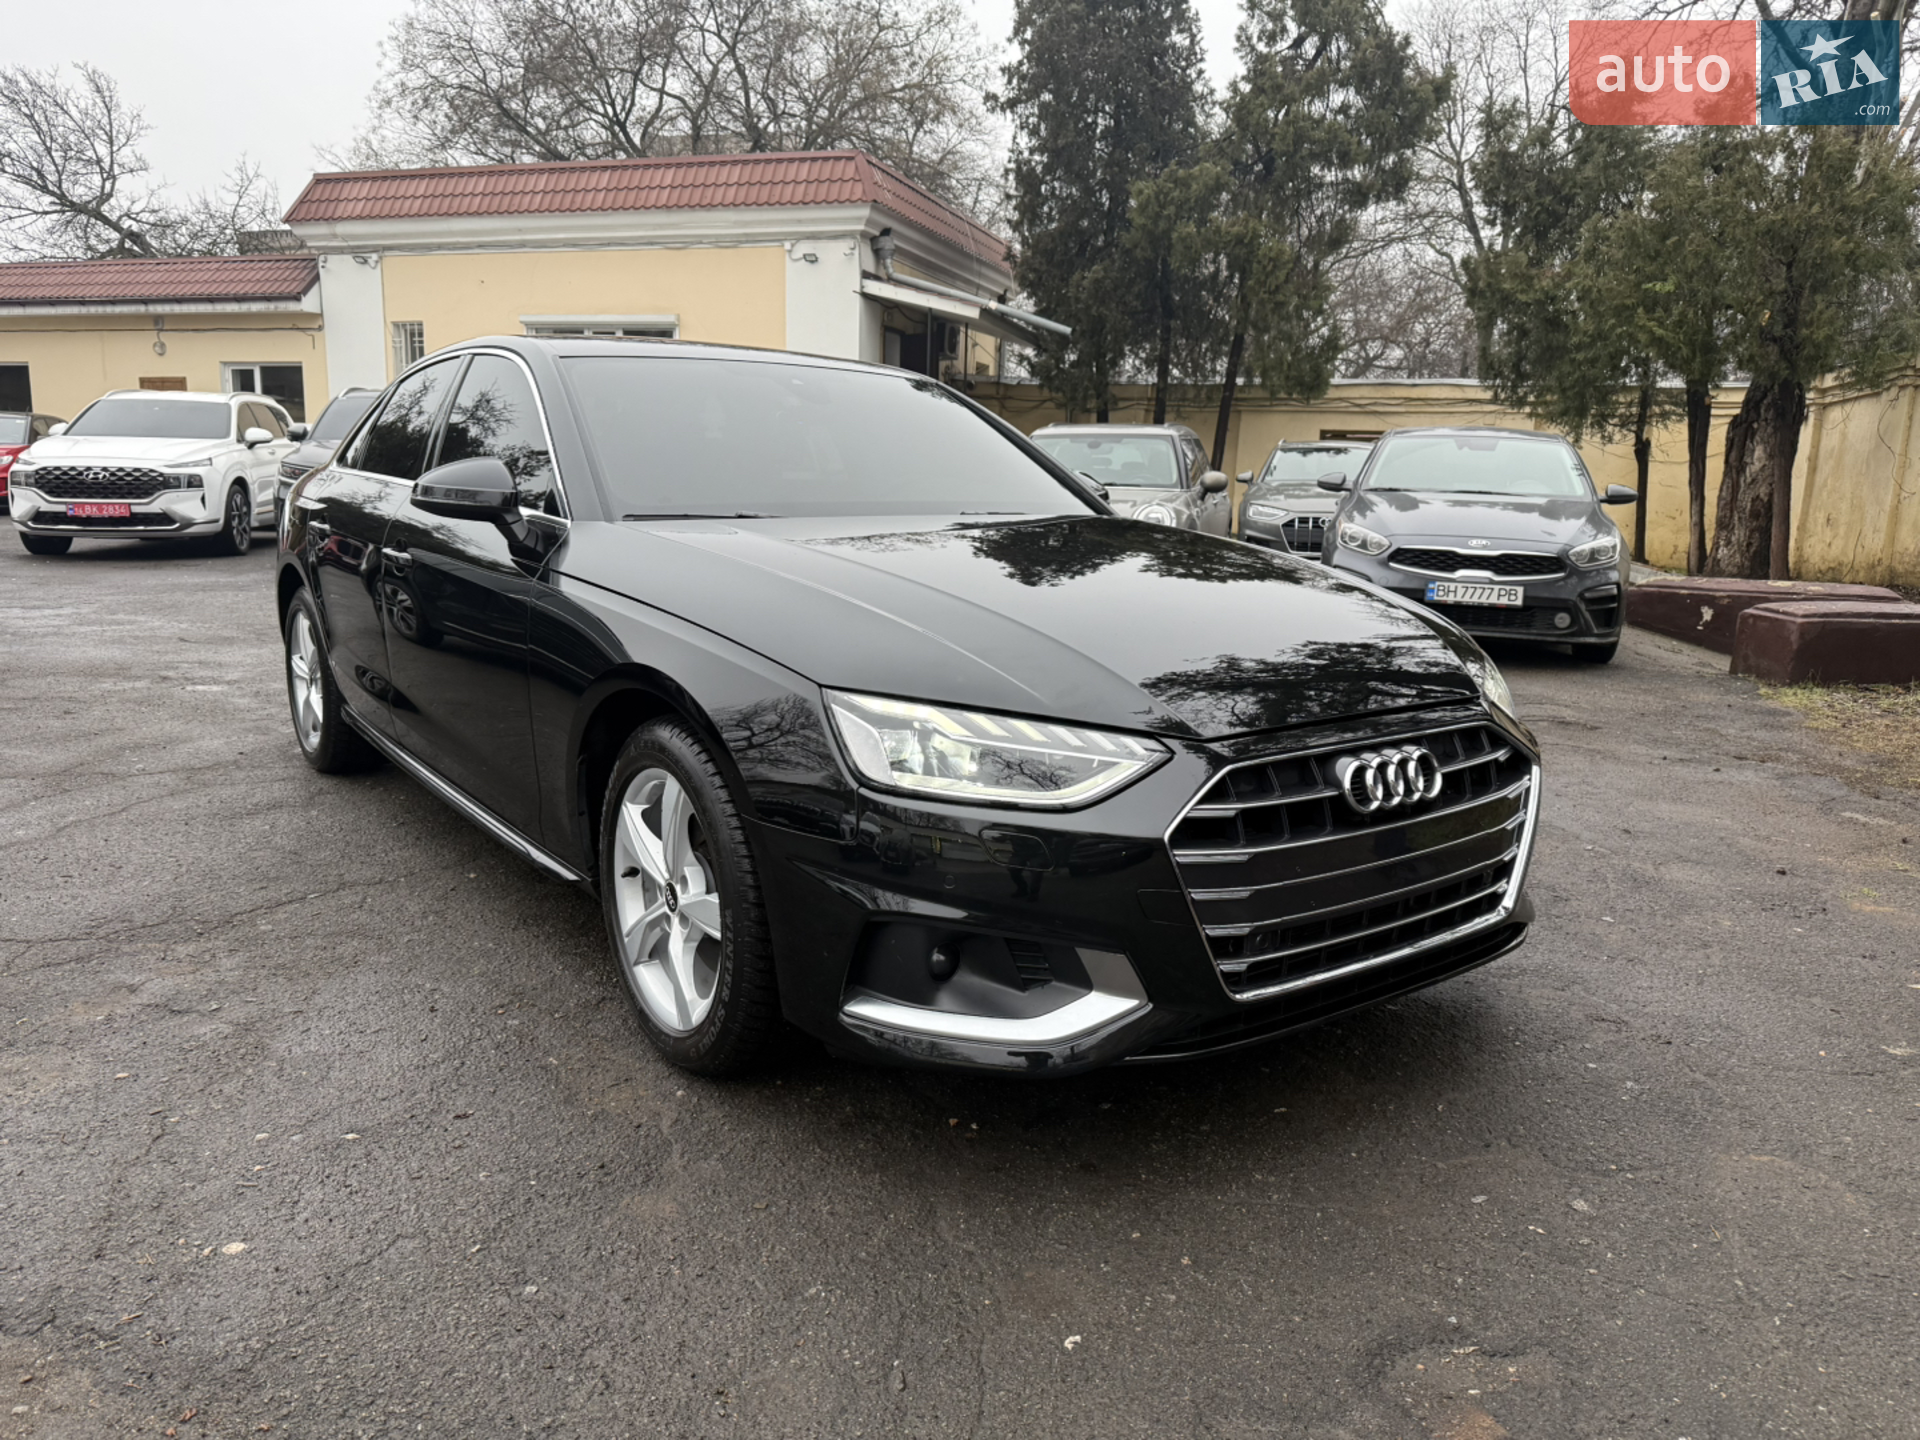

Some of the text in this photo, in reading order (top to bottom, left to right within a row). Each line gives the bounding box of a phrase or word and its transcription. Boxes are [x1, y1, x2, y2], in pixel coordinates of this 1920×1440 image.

[85, 505, 99, 514] BK
[102, 505, 125, 514] 2834
[1435, 585, 1518, 601] BH 7777 PB
